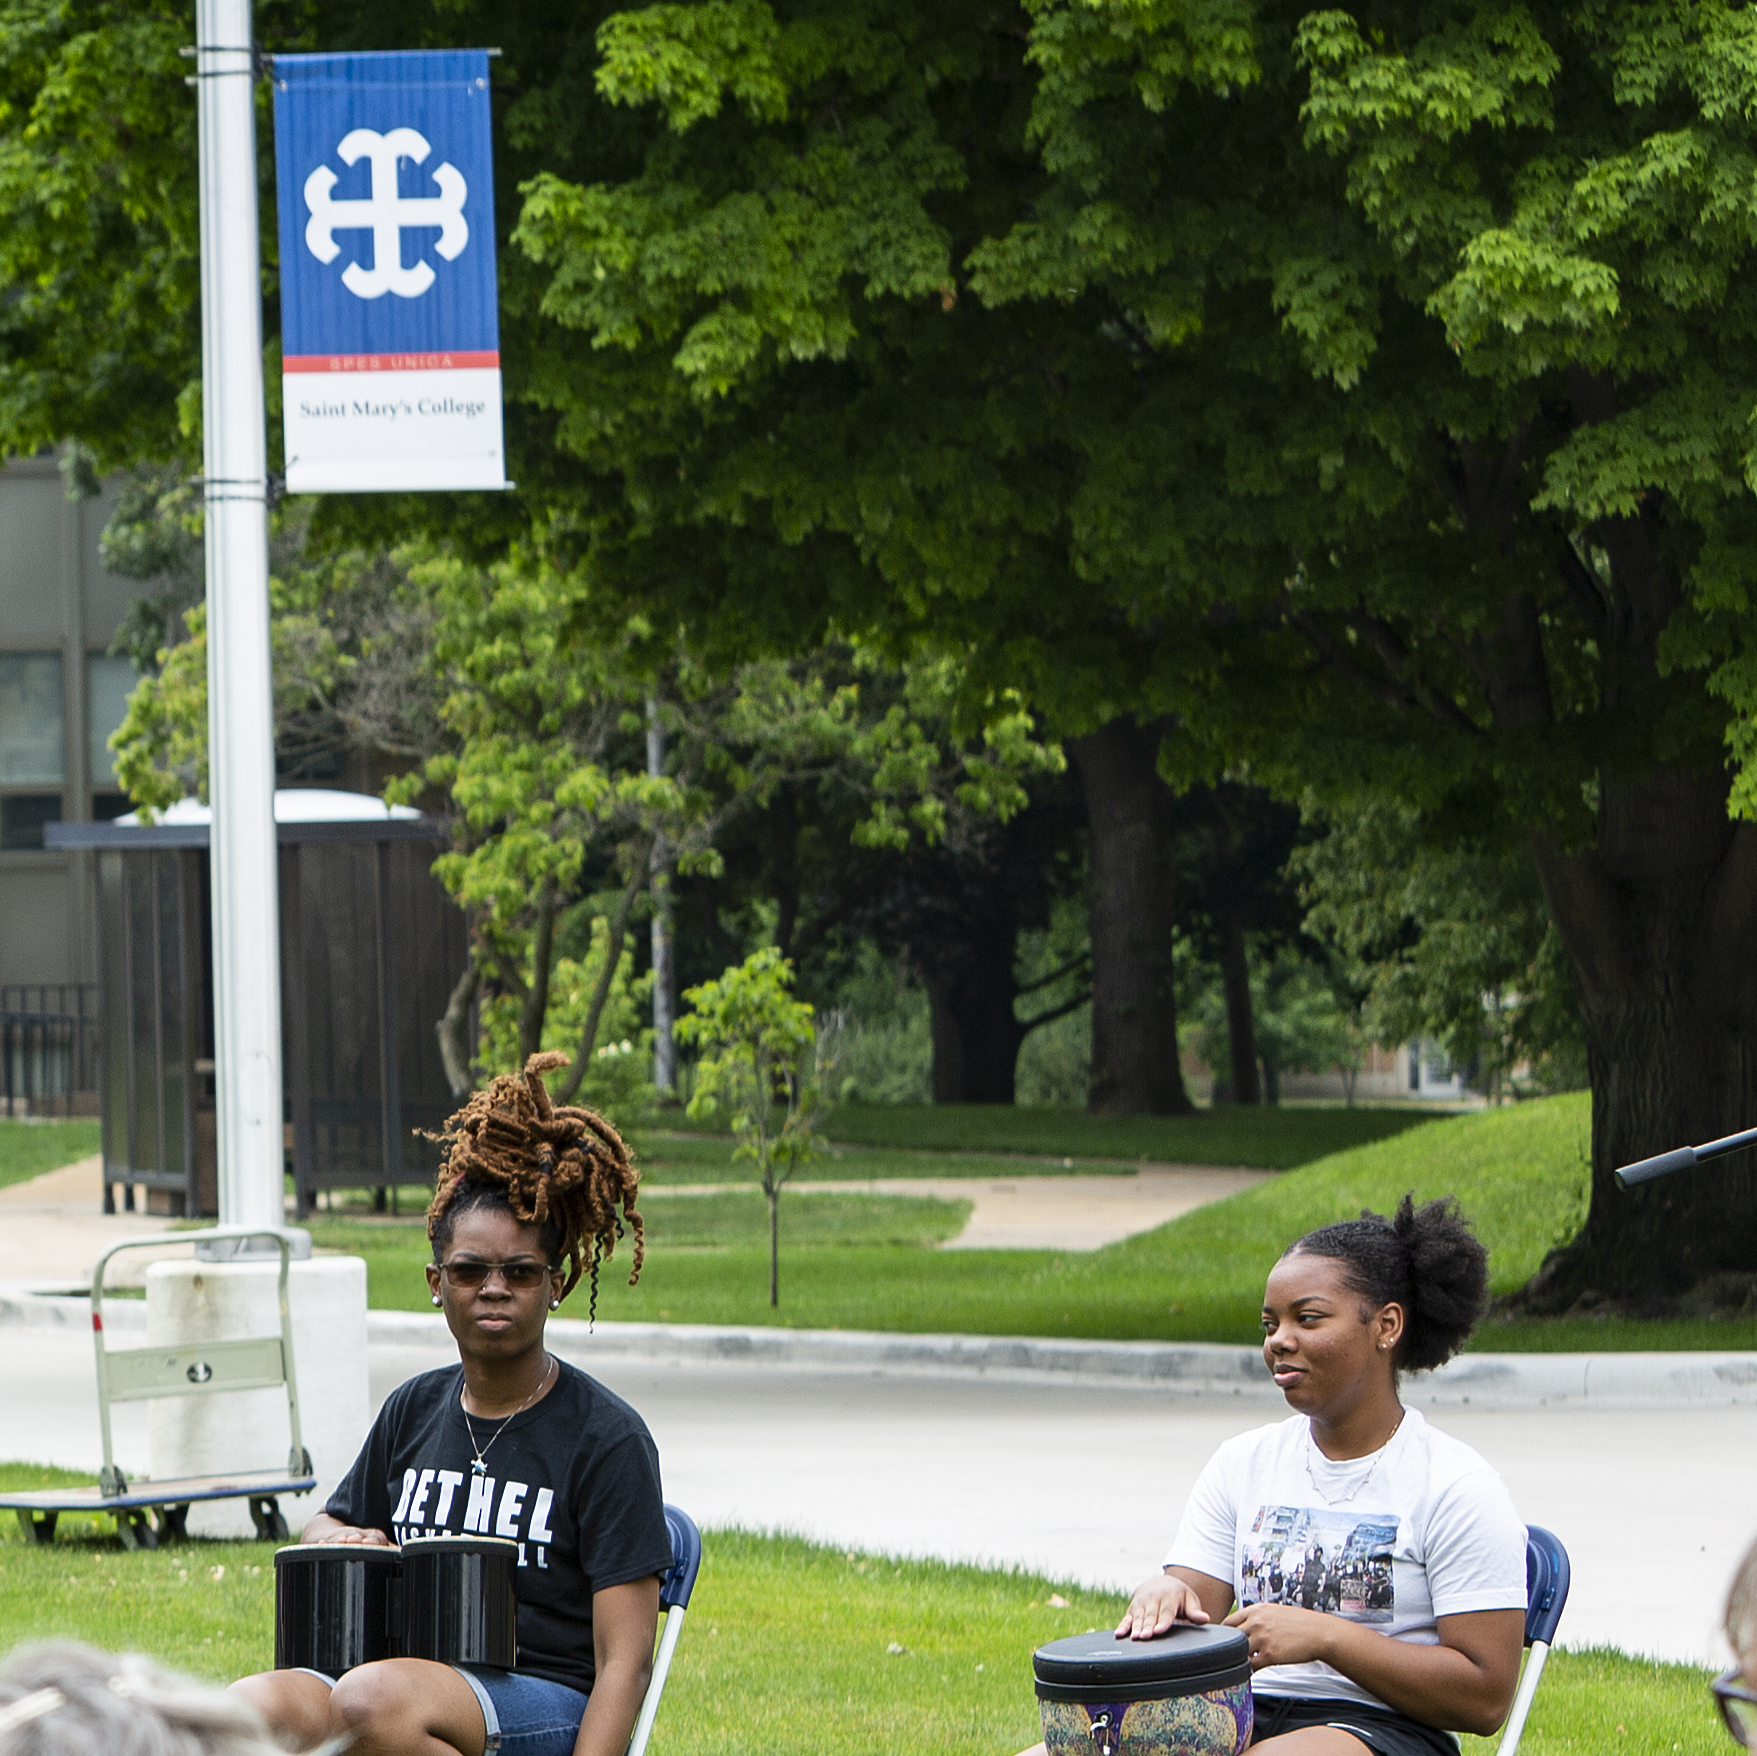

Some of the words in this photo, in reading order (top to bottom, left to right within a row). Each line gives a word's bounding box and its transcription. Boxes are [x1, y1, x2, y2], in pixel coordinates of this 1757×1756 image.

[330, 356, 380, 370] SPES
[391, 354, 453, 369] UNICA
[300, 400, 346, 417] Saint
[353, 399, 412, 421] Mary's
[418, 396, 485, 418] College
[391, 1468, 554, 1543] BETHEL
